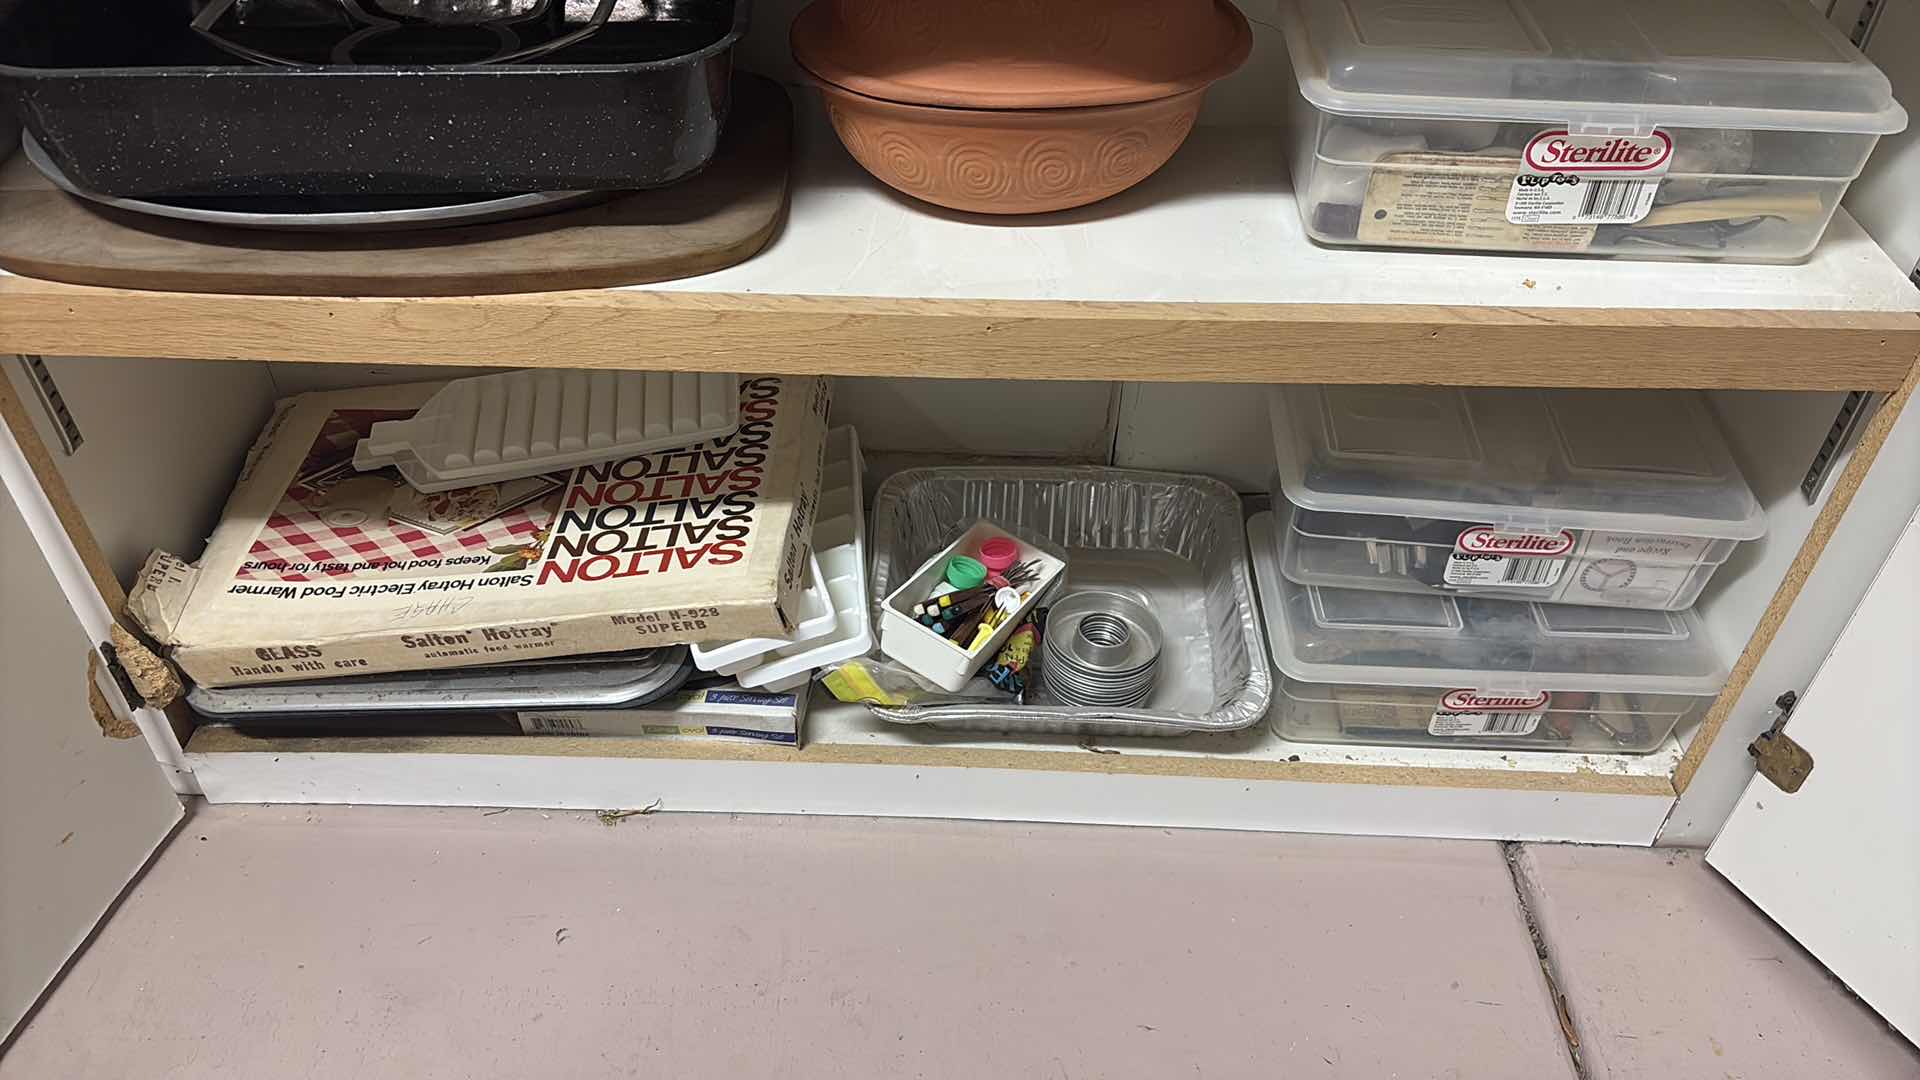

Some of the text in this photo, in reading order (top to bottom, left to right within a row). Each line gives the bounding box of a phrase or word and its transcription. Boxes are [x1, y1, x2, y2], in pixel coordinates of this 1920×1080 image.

[575, 444, 769, 484] SALTON
[566, 466, 764, 509] SALTON
[557, 491, 758, 533] SALTON
[547, 515, 752, 559] SALTON
[244, 555, 491, 573] Keeps food hot and tasty for hours
[536, 539, 747, 585] SALTON
[227, 574, 534, 599] Salton Hotray Electric Food Warmer
[610, 607, 720, 625] Model H-928
[635, 620, 707, 635] SUPERB
[255, 644, 323, 661] GLASS
[483, 644, 508, 653] food
[513, 640, 555, 650] warmer
[230, 657, 368, 677] Handle with care
